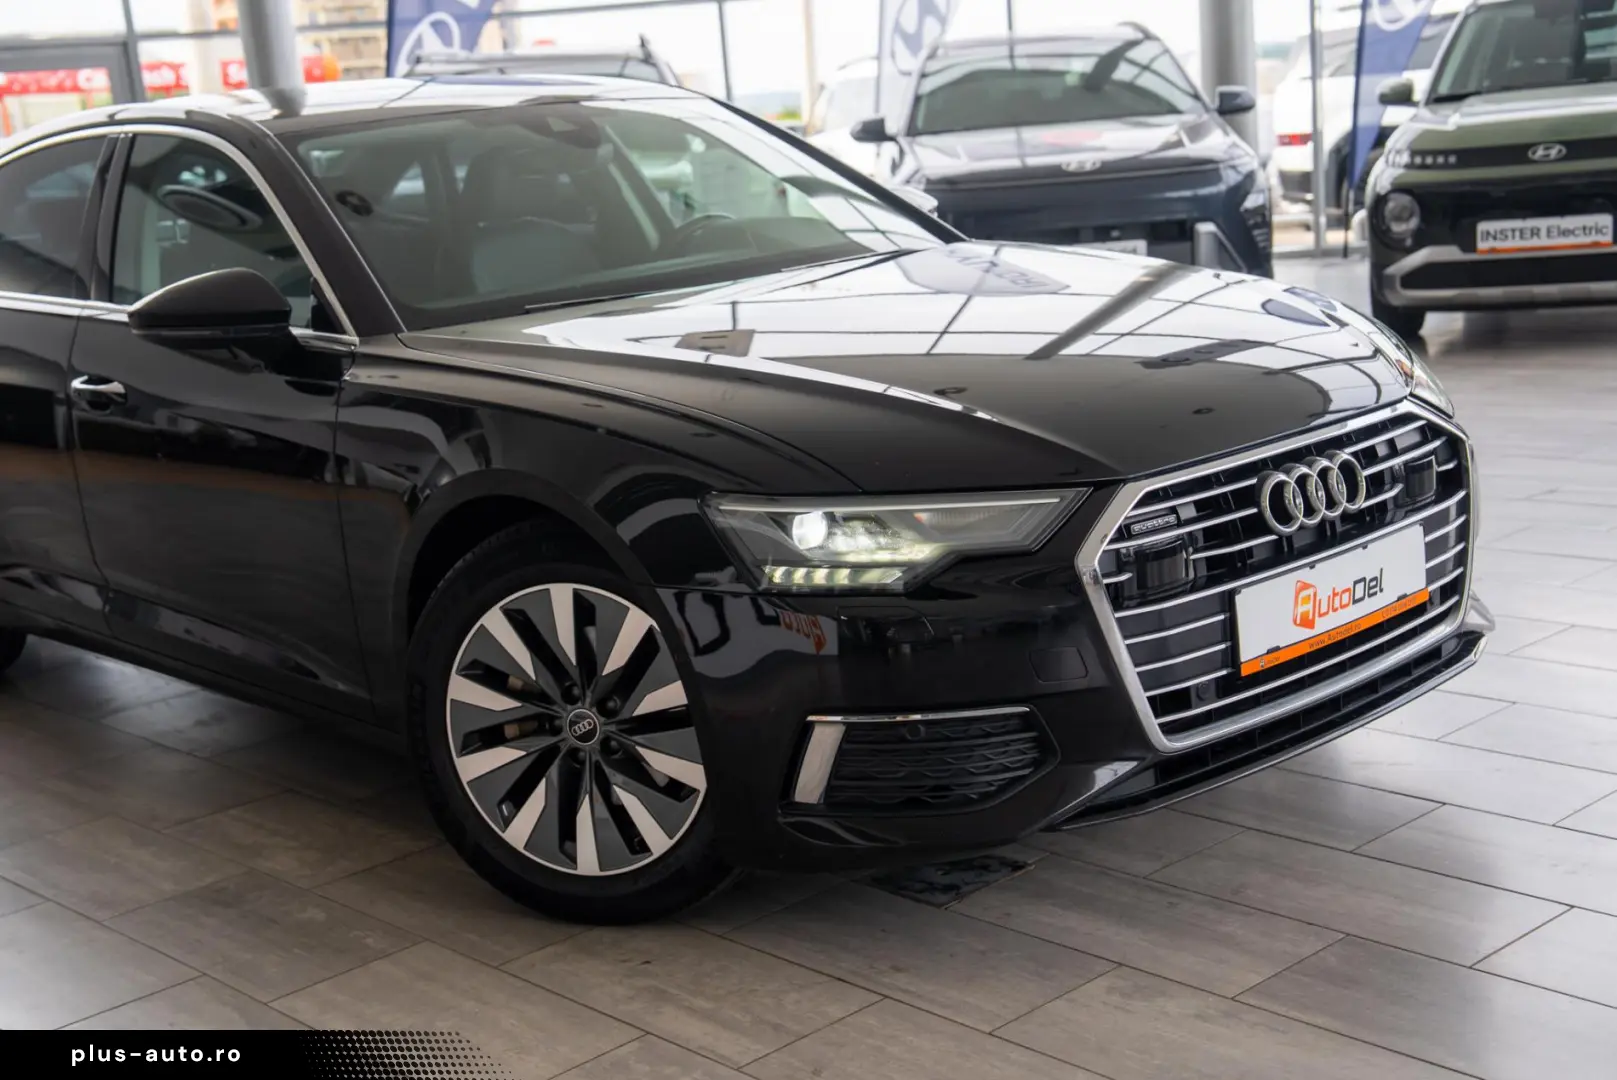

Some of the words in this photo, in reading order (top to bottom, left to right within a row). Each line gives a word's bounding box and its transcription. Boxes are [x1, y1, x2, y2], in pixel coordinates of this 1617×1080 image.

[1479, 226, 1542, 243] INSTER
[1546, 221, 1609, 239] Electric
[1292, 567, 1383, 630] AutoDel
